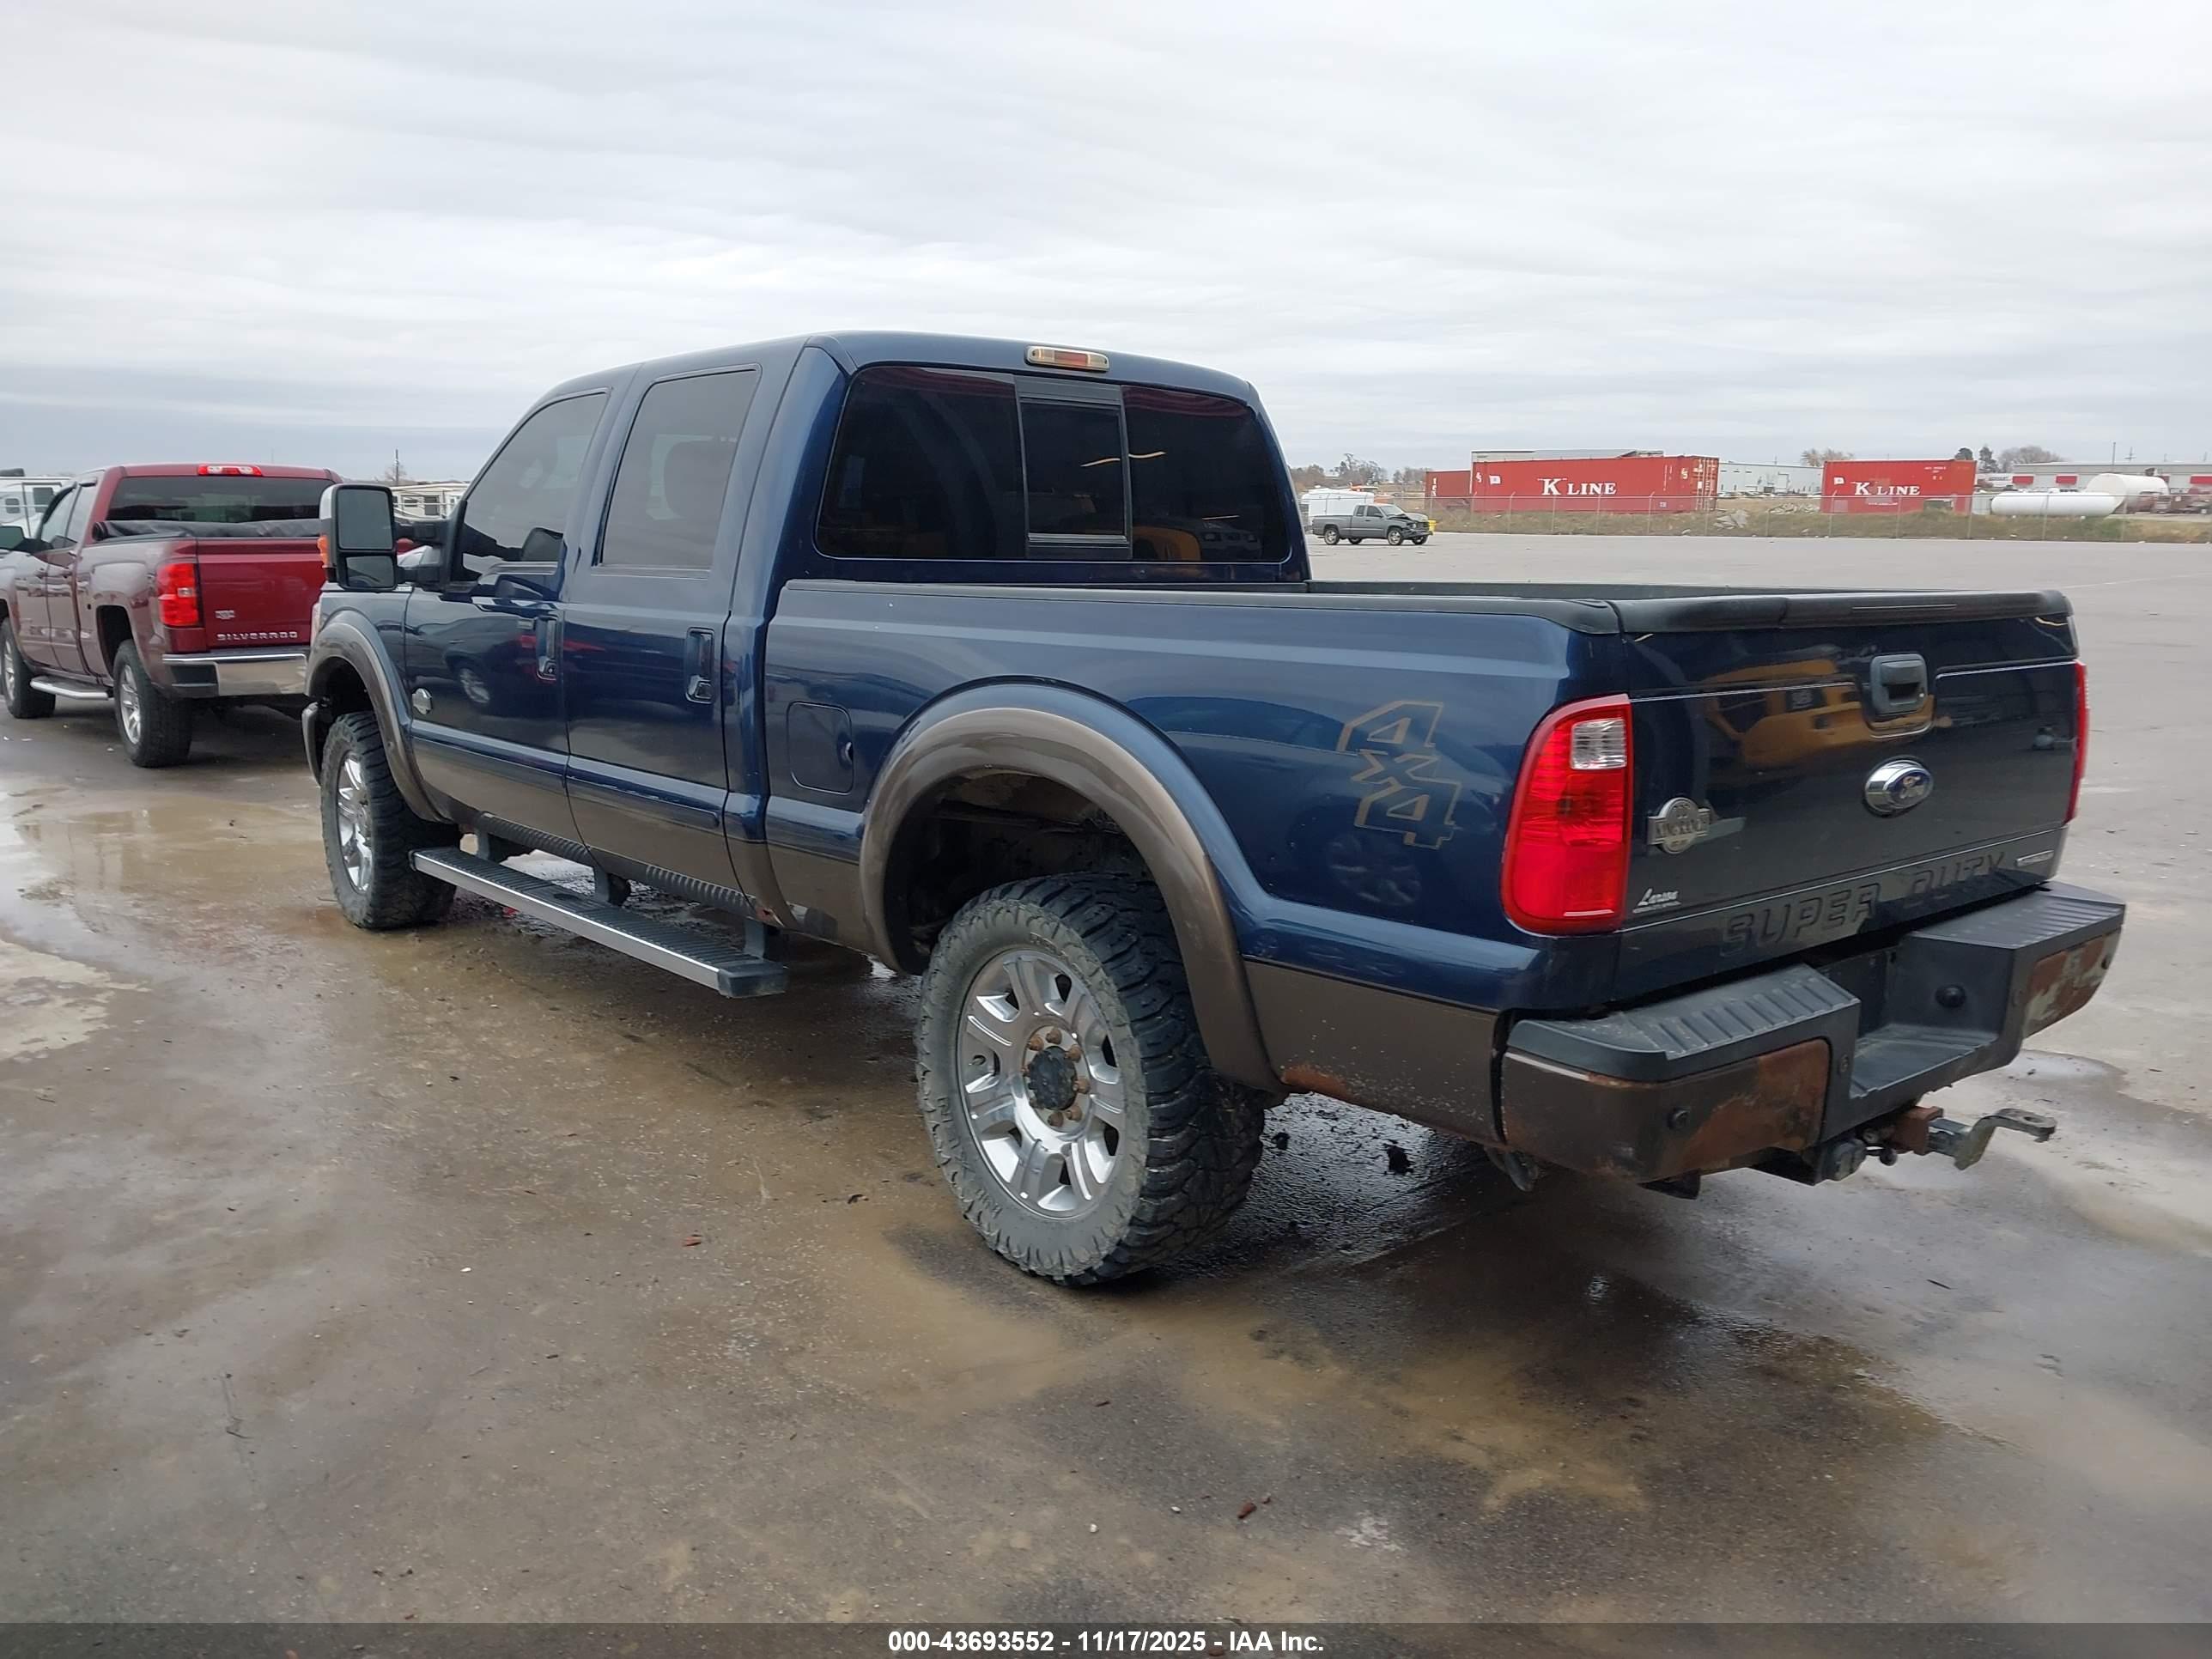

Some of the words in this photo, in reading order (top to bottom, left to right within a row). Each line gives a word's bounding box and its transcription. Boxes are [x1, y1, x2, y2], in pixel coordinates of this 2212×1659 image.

[1540, 477, 1563, 495] K
[1567, 482, 1617, 495] LINE
[1853, 482, 1872, 495] K
[1876, 486, 1921, 495] LINE
[216, 631, 298, 641] SILVERADO
[1720, 882, 1881, 957] SUPER
